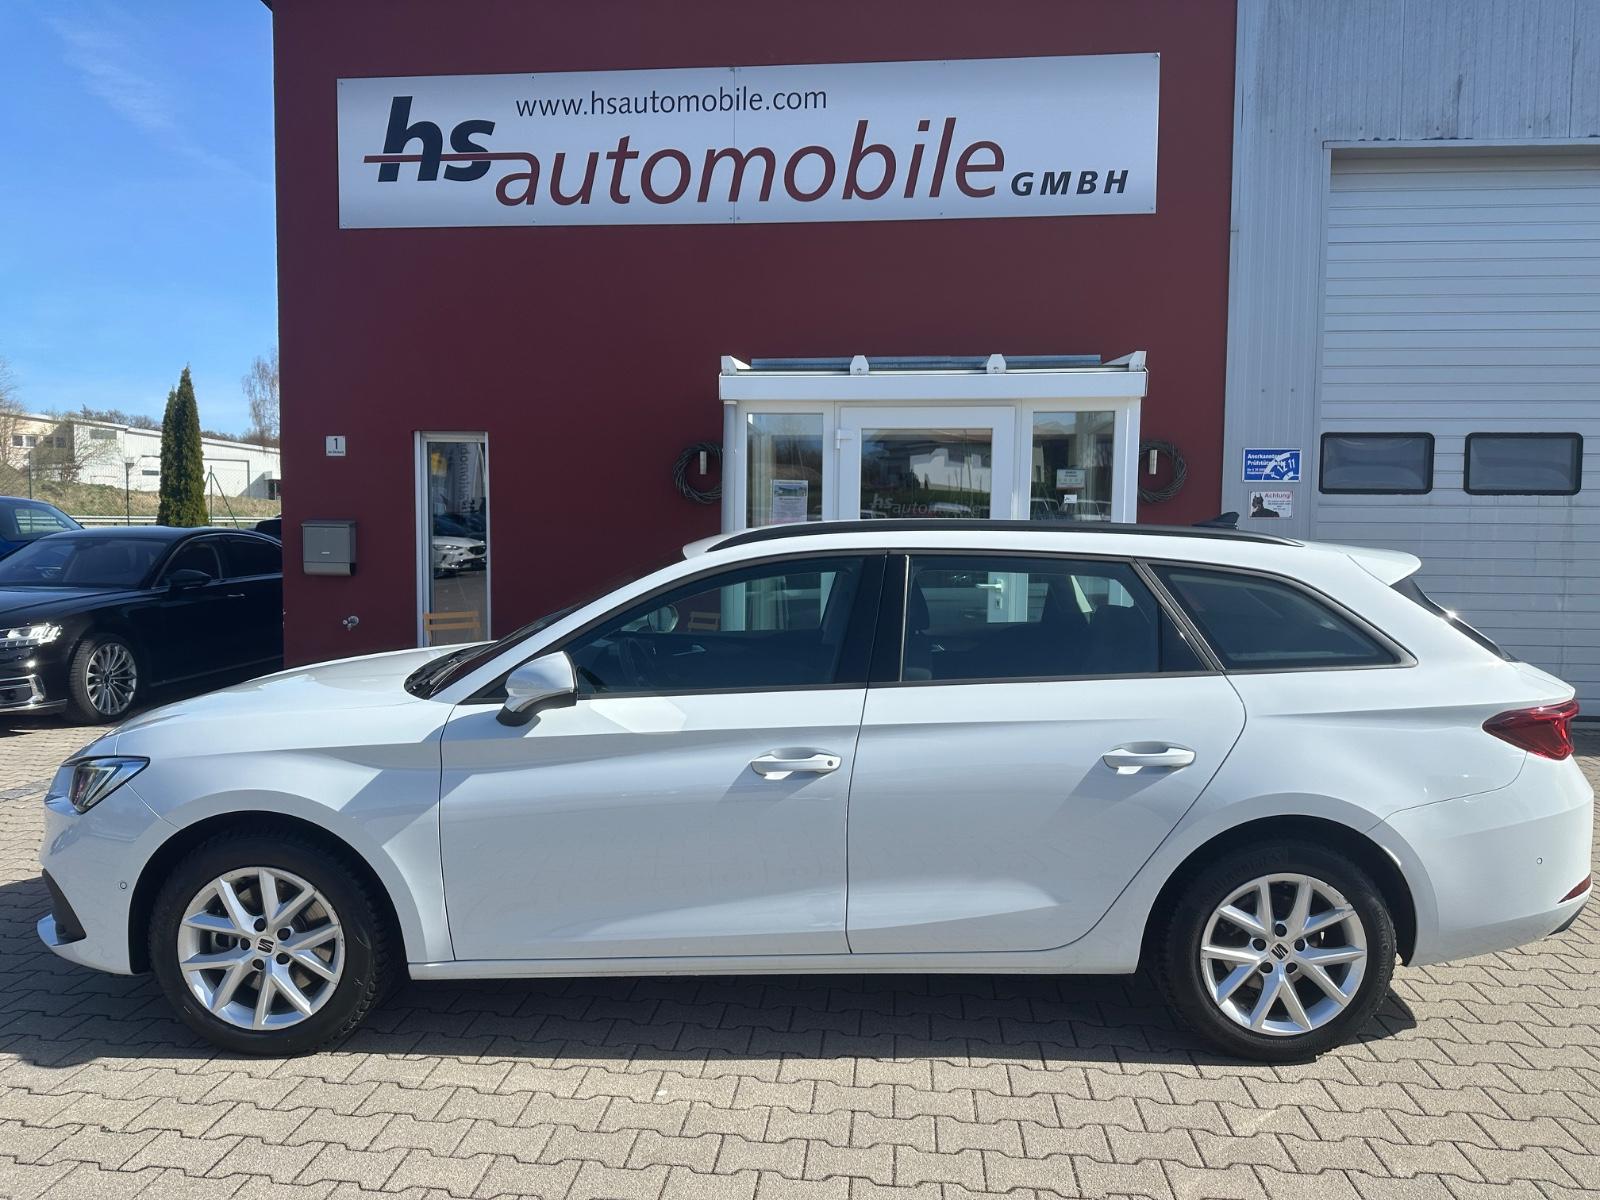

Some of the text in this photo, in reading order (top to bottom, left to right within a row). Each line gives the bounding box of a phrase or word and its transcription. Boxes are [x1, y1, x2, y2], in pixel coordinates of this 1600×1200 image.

[515, 85, 827, 117] www.hsautomobile.com
[377, 95, 1129, 207] hs automobile GMBH
[334, 437, 338, 450] 1
